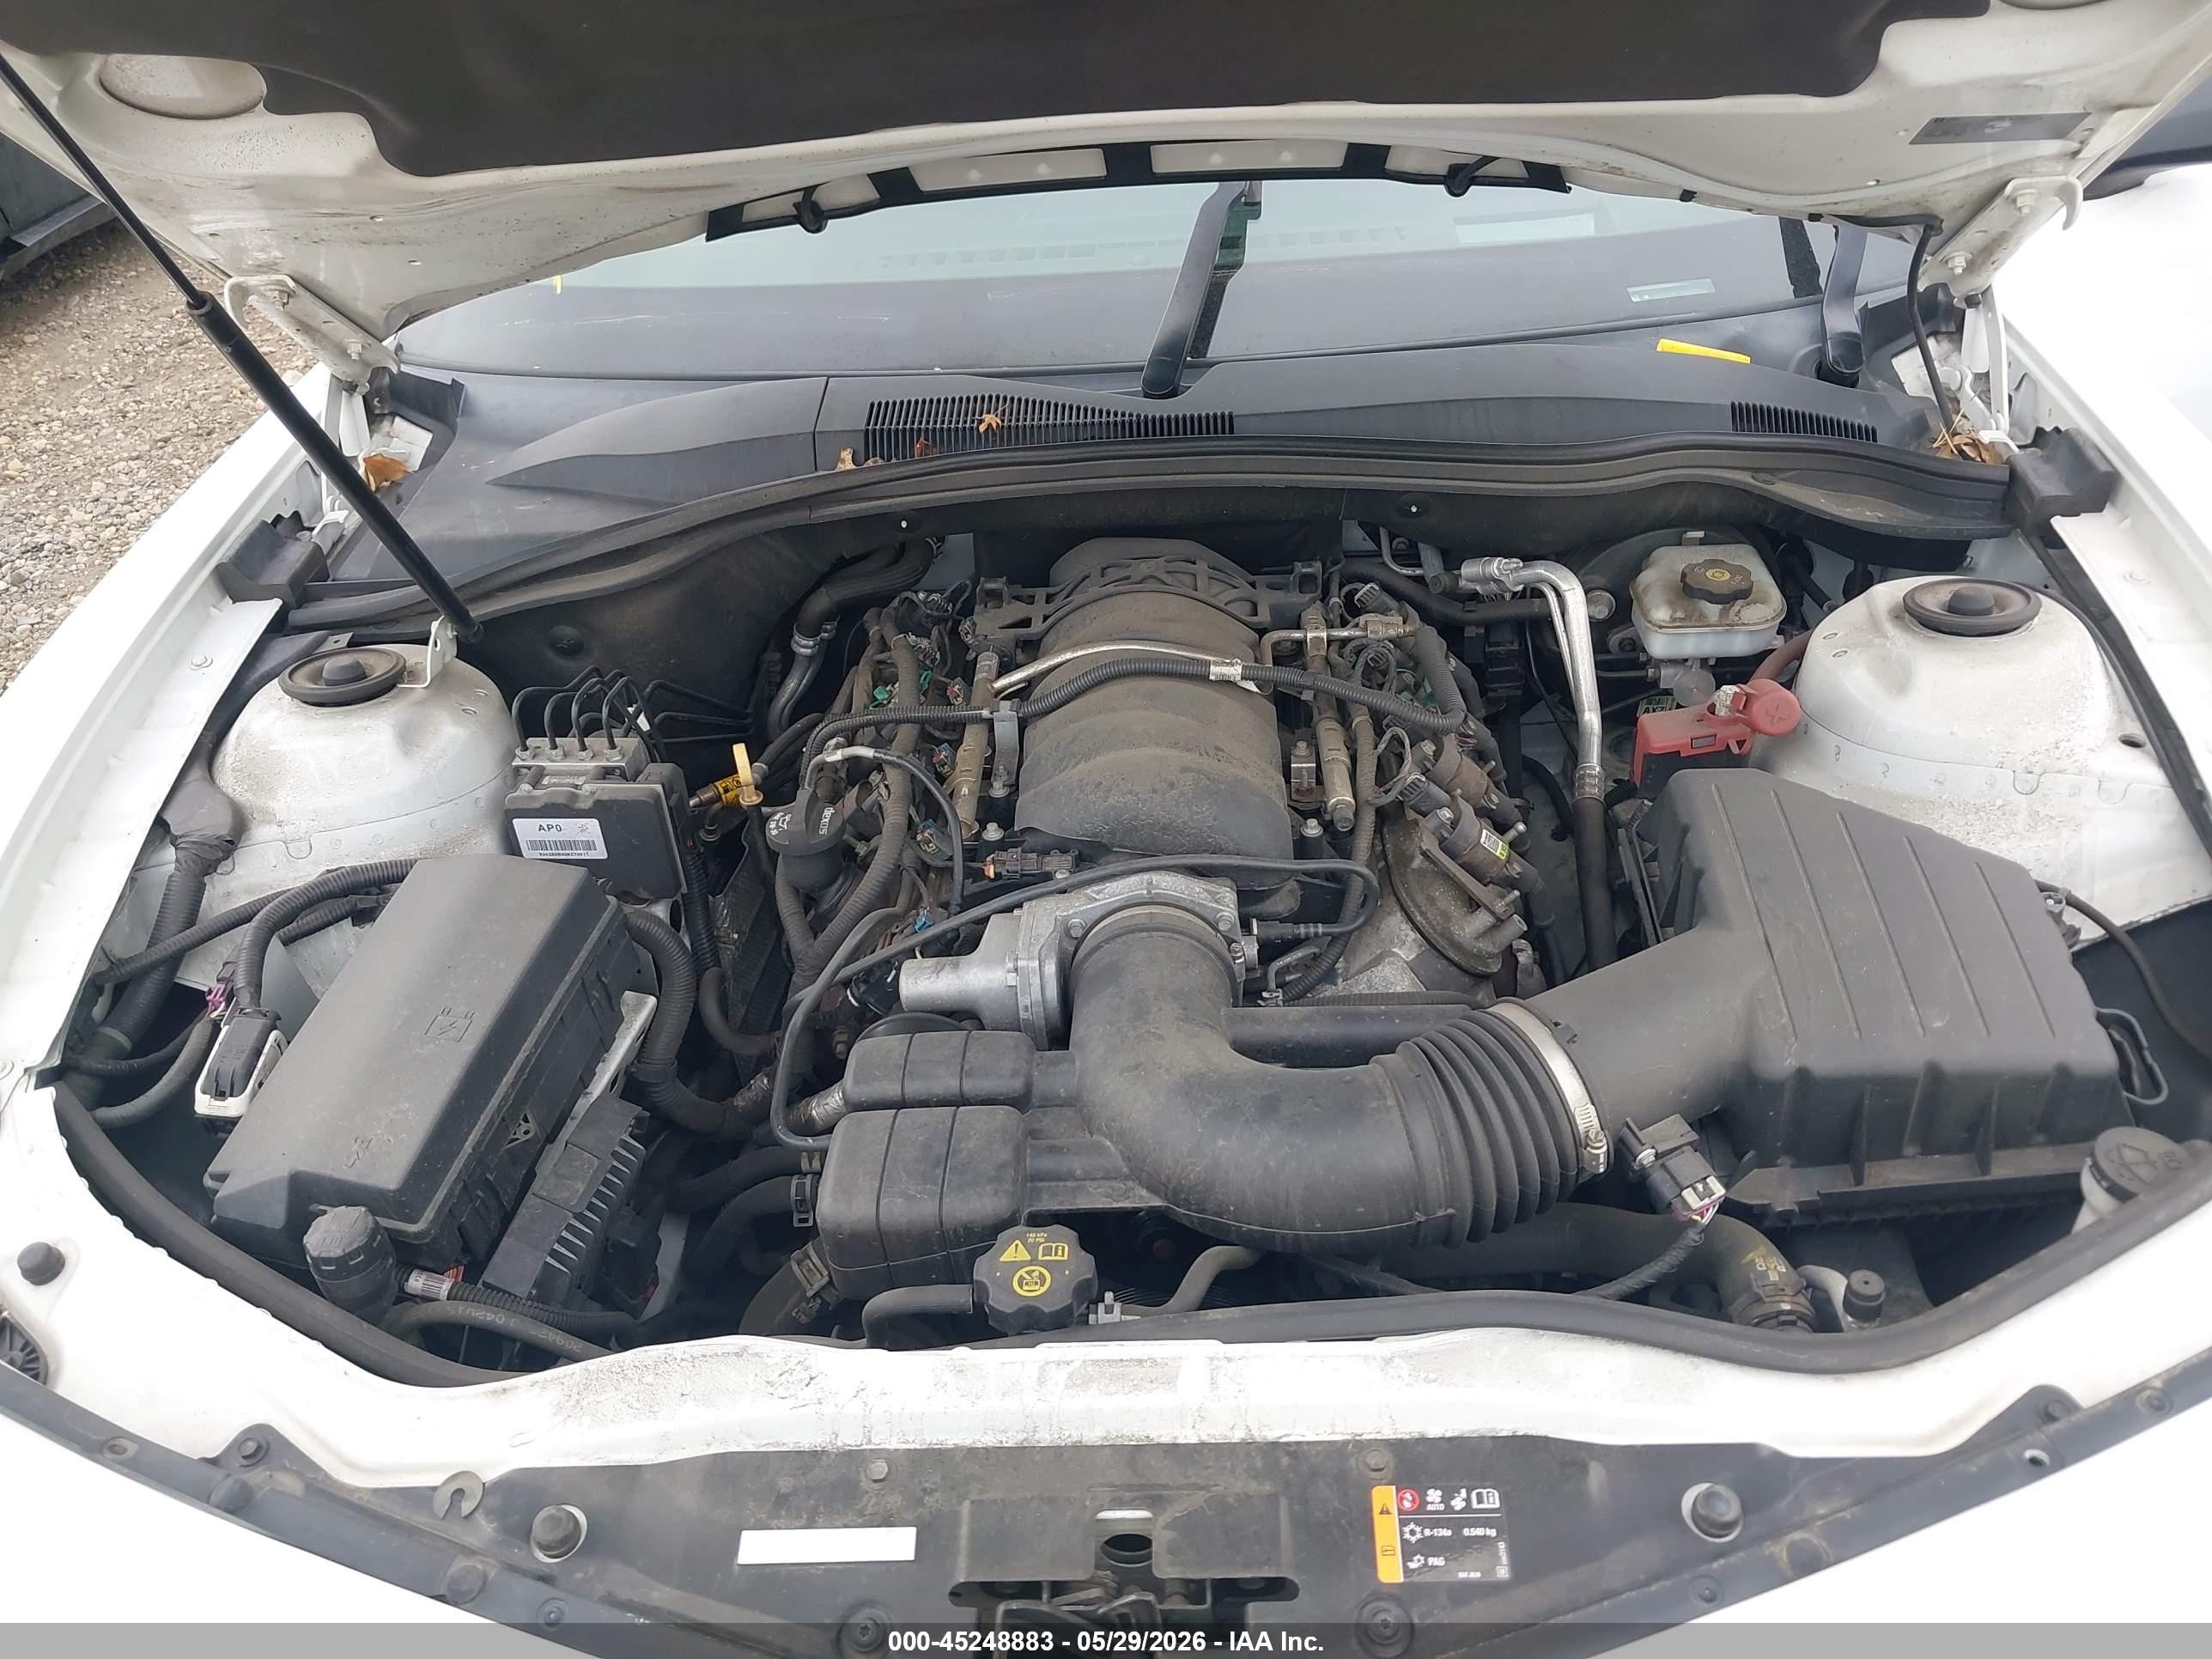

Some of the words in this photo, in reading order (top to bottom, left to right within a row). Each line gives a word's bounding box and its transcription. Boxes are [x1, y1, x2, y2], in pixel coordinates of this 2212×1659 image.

[818, 807, 836, 836] dexos
[1424, 1528, 1452, 1537] R-134a
[1462, 1527, 1485, 1536] 0.540
[1486, 1527, 1497, 1537] kg
[1427, 1557, 1446, 1566] PAG
